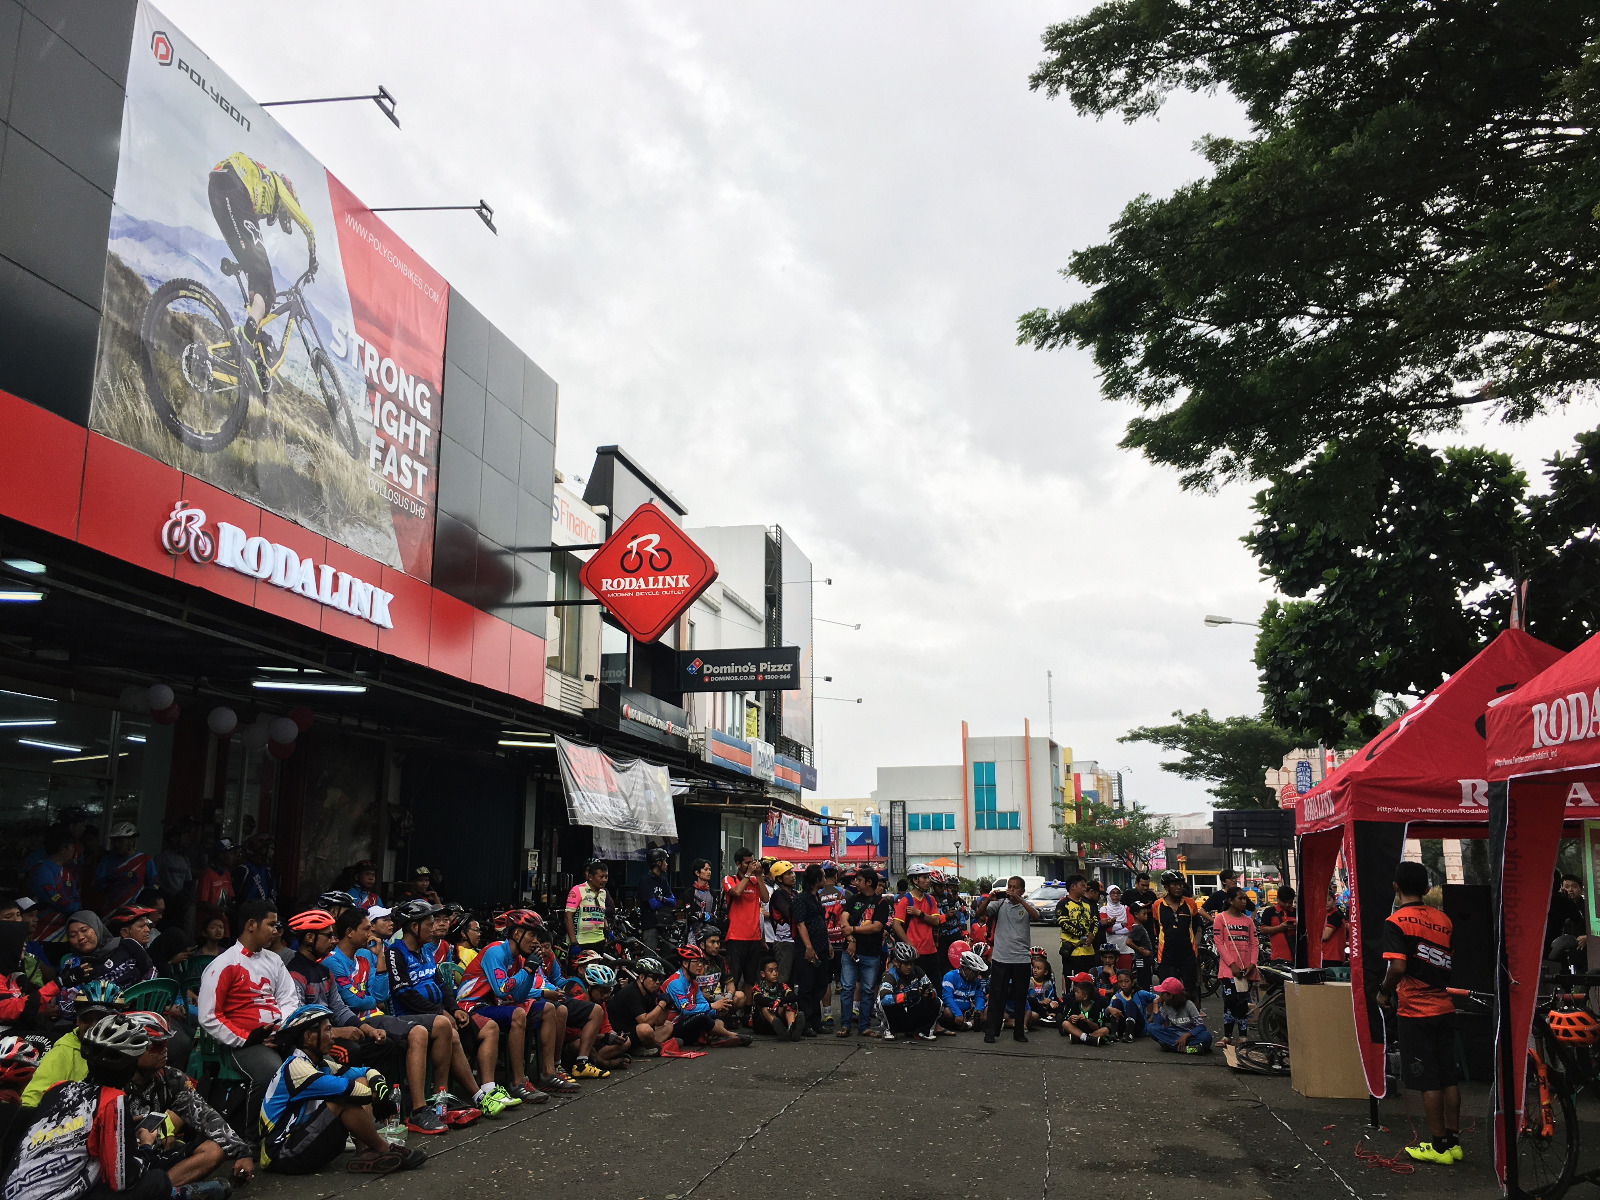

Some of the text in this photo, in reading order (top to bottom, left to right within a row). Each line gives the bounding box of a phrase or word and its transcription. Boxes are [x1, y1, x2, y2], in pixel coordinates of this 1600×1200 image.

[178, 57, 251, 132] POLYGON
[344, 212, 439, 304] WWW.POLYGONBIKES.COM
[329, 319, 431, 420] STRONG
[357, 384, 431, 458] LIGHT
[369, 433, 428, 497] FAST
[410, 501, 426, 519] DH9
[214, 521, 394, 629] RODALINK
[601, 575, 690, 592] RODALINK
[703, 661, 792, 674] Domino's Pizza
[1397, 917, 1452, 935] POLYGO
